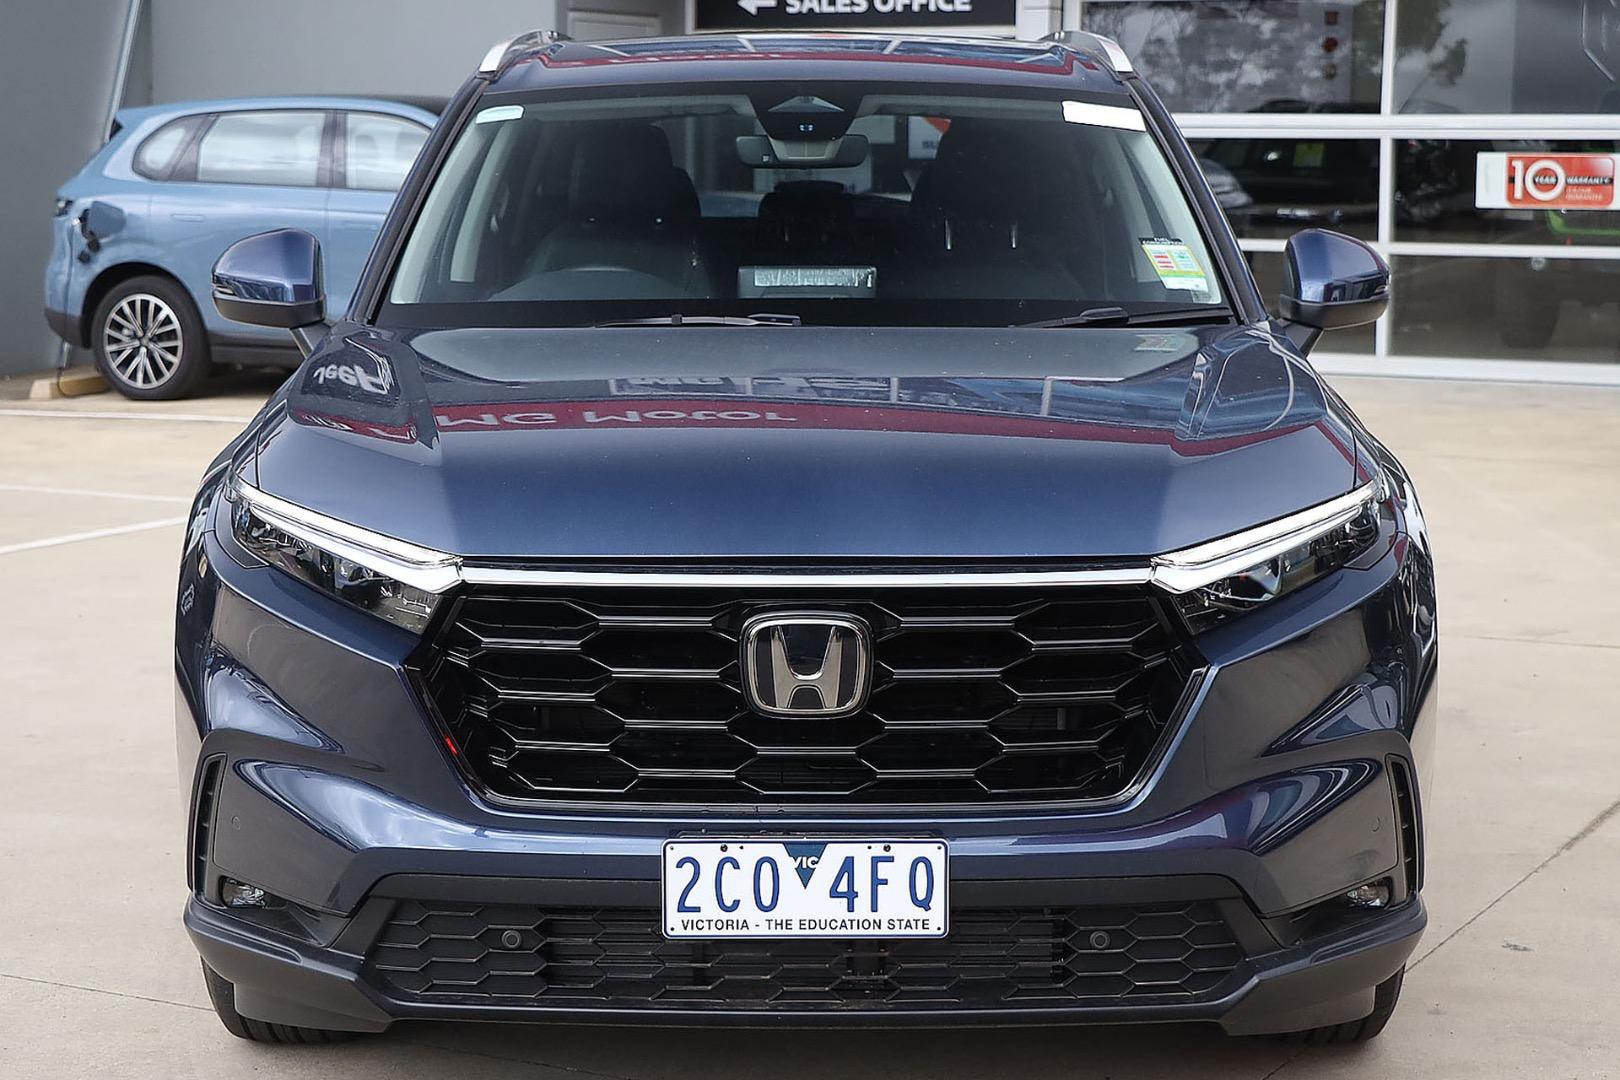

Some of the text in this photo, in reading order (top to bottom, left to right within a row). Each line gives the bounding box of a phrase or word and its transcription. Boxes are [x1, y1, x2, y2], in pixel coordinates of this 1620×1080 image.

[785, 0, 972, 14] SALES OFFICE
[1511, 160, 1566, 201] 10
[681, 919, 750, 931] VICTORIA
[766, 919, 793, 931] THE
[799, 919, 882, 931] EDUCATION
[887, 919, 930, 931] STATE
